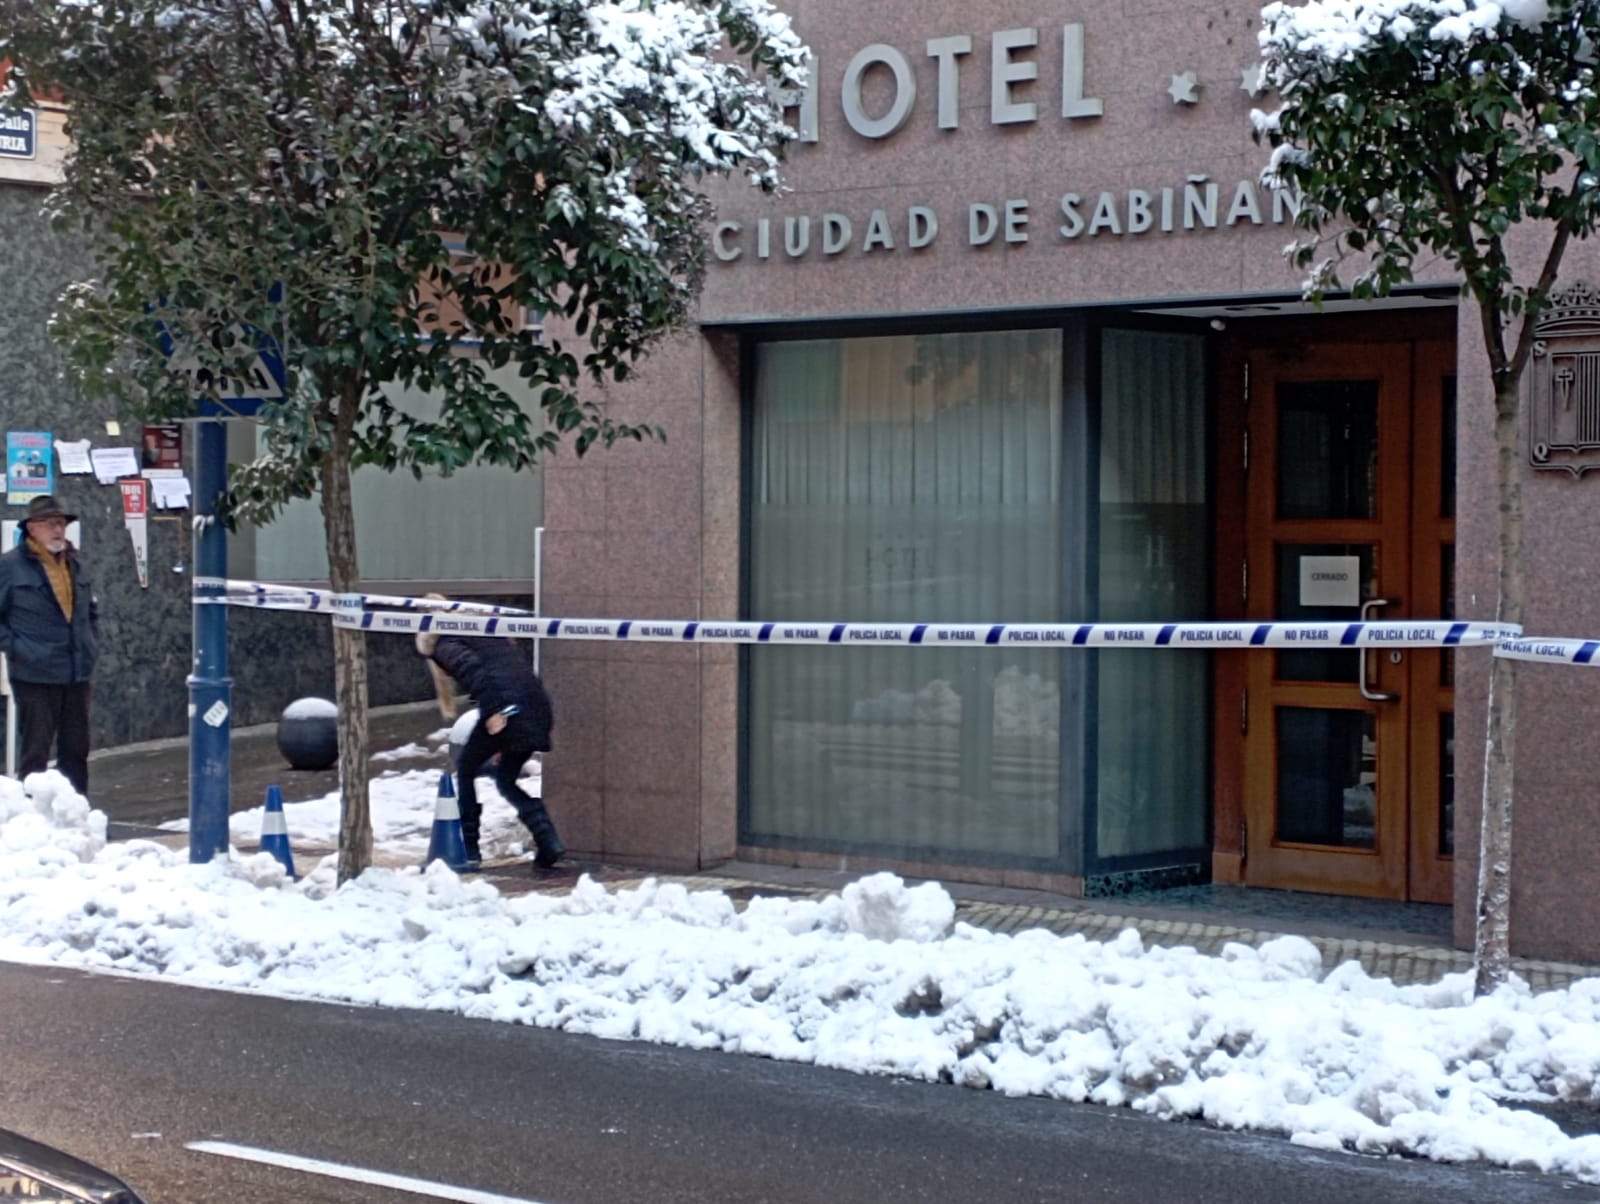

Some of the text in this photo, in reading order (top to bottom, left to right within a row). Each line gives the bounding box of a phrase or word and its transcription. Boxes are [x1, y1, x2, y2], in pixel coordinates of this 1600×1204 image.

[766, 22, 1103, 143] HOTEL
[713, 205, 939, 262] CIUDAD
[969, 199, 1029, 247] DE
[702, 628, 728, 638] POLICIA
[730, 628, 752, 638] LOCAL
[796, 629, 819, 639] PASAR
[850, 630, 877, 641] POLICIA
[880, 631, 903, 641] LOCAL
[938, 631, 948, 641] NO
[950, 631, 975, 641] PASAR
[1008, 631, 1039, 641] POLICIA
[1041, 631, 1066, 641] LOCAL
[1104, 630, 1115, 641] NO
[1118, 631, 1145, 641] PASAR
[1180, 630, 1213, 641] POLICIA
[1216, 631, 1243, 641] LOCAL
[1285, 630, 1297, 640] NO
[1300, 630, 1329, 641] PASAR
[1368, 629, 1404, 641] POLICIA
[1407, 630, 1436, 641] LOCAL
[1536, 644, 1566, 657] LOCAL
